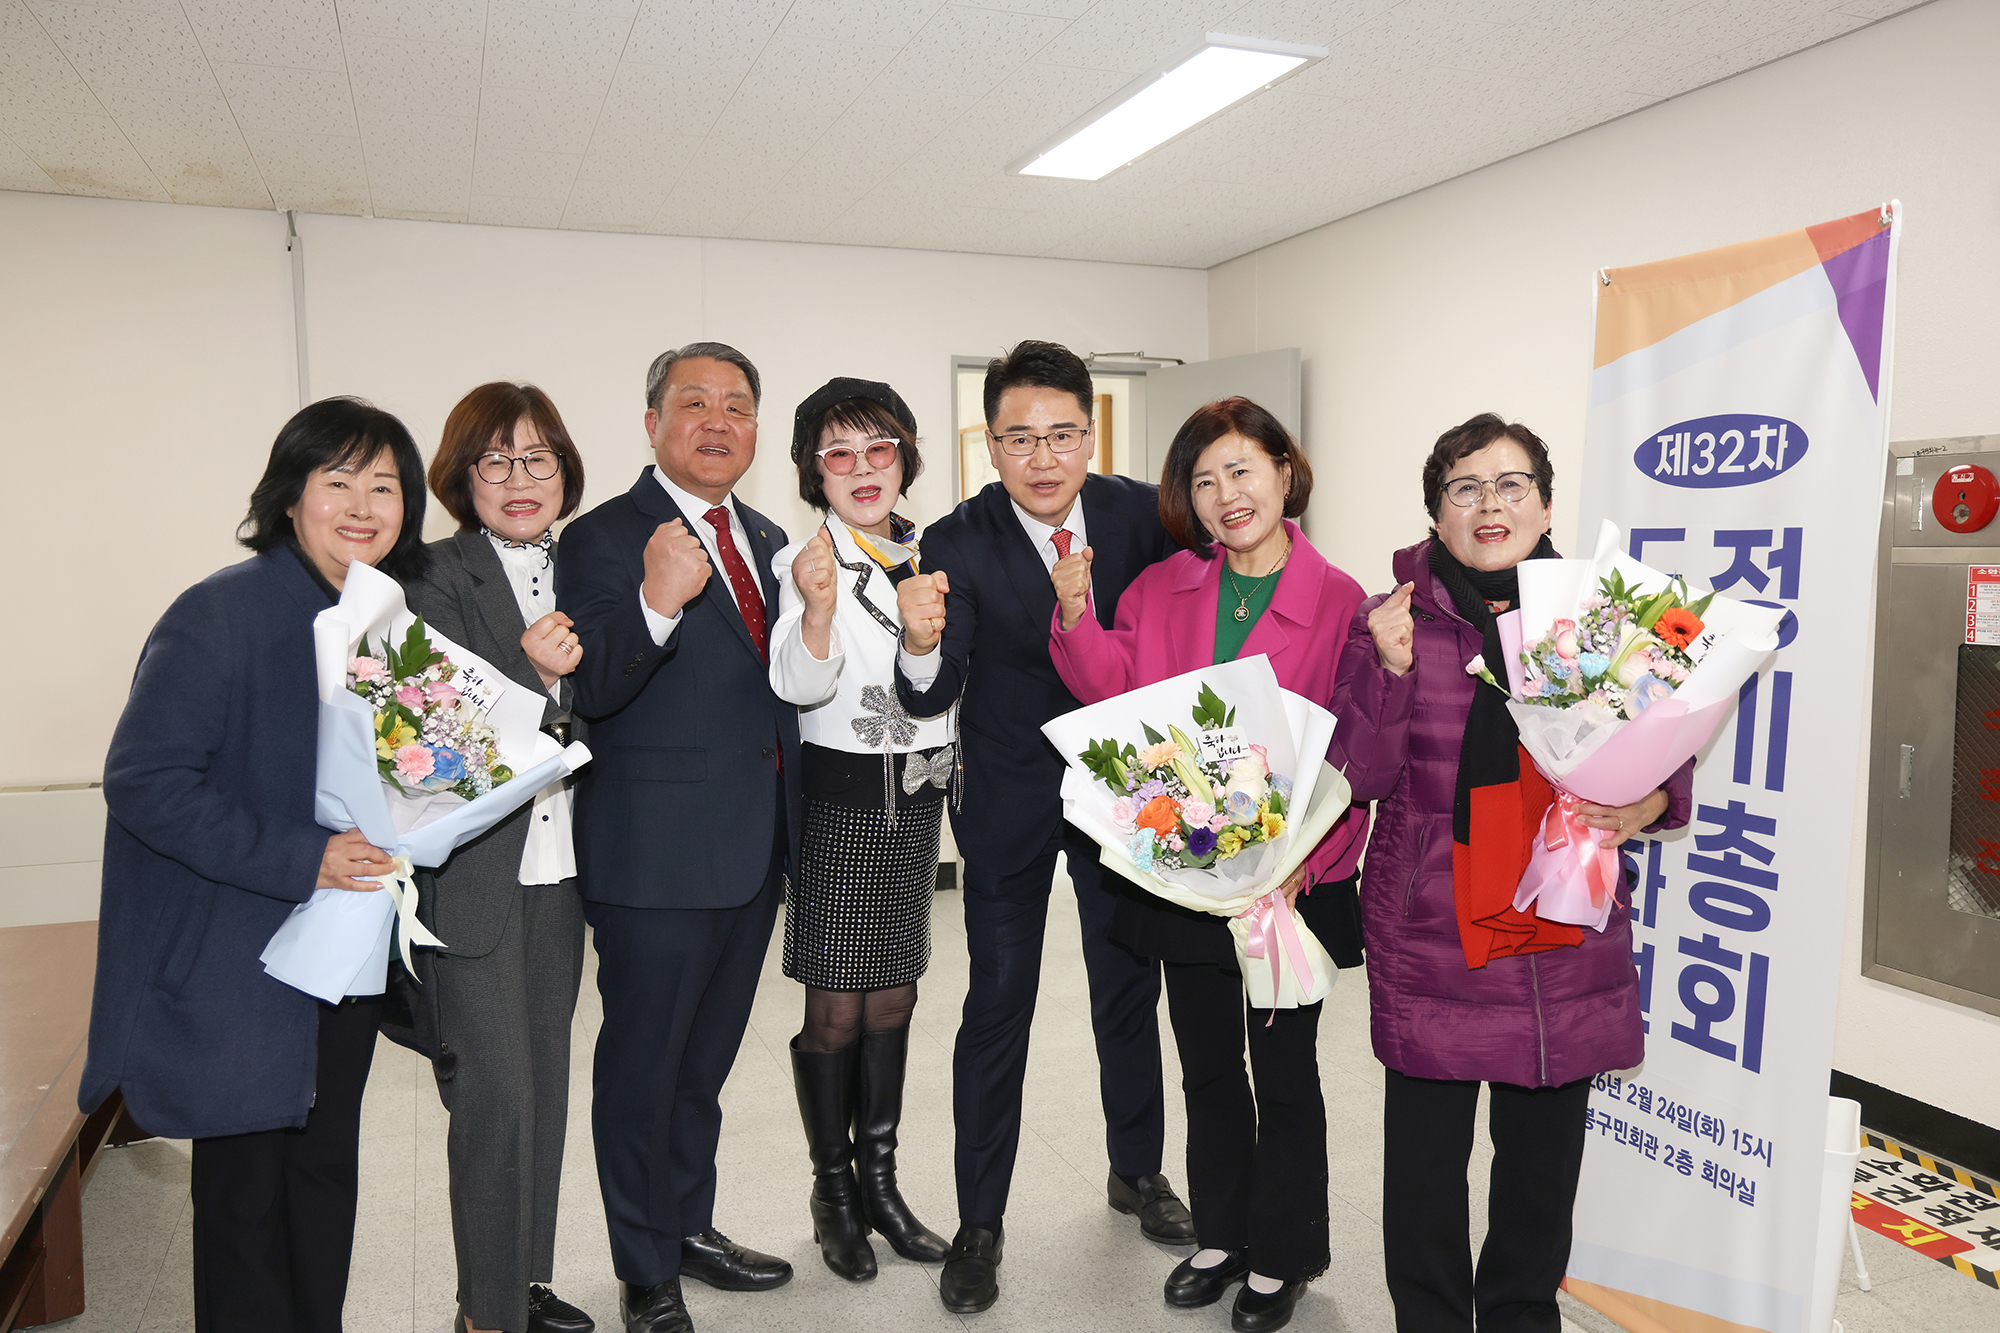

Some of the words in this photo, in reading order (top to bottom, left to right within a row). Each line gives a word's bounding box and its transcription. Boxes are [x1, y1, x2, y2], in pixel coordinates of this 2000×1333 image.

[1654, 423, 1789, 476] 제32차
[1970, 585, 1976, 597] 1
[1968, 600, 1976, 611] 2
[1968, 614, 1975, 626] 3
[1967, 629, 1975, 641] 4
[1202, 734, 1225, 748] 축하
[1627, 1083, 1653, 1114] 2월
[1656, 1096, 1726, 1146] 24일(화)
[1732, 1128, 1773, 1168] 15시
[1663, 1144, 1694, 1177] 2층
[1701, 1159, 1756, 1207] 회의실
